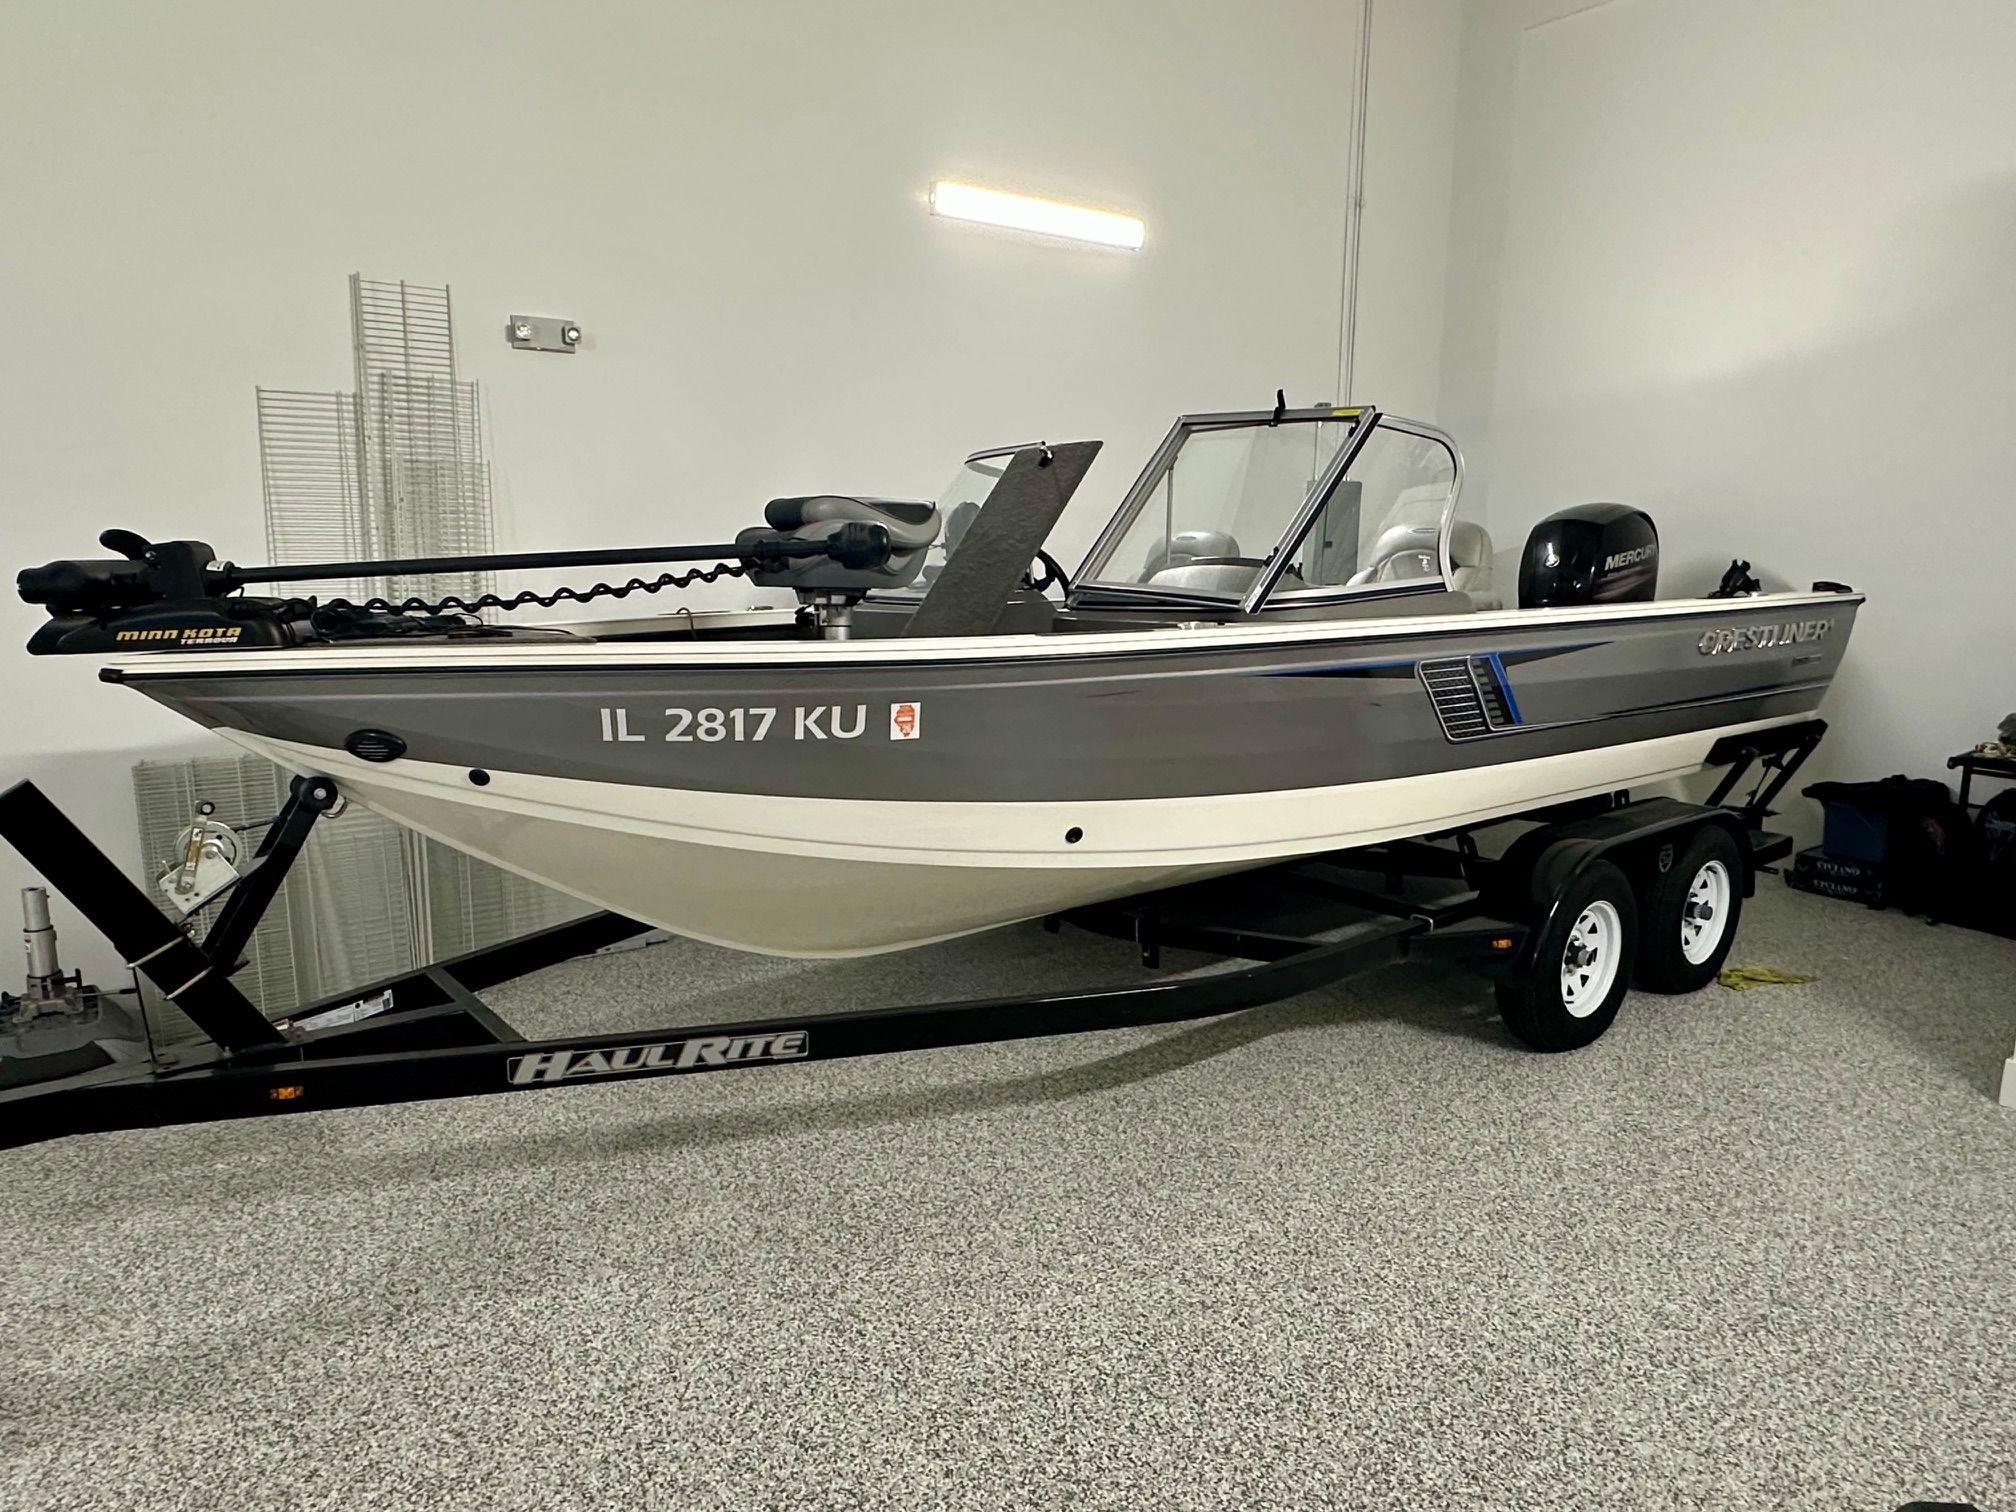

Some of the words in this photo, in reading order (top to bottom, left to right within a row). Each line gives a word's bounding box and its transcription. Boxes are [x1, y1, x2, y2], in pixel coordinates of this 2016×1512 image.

[116, 629, 179, 641] MINN
[182, 626, 242, 639] KOTA
[1698, 619, 1830, 656] CRESTLINER
[600, 708, 645, 742] IL
[665, 707, 777, 742] 2817
[794, 704, 867, 740] KU
